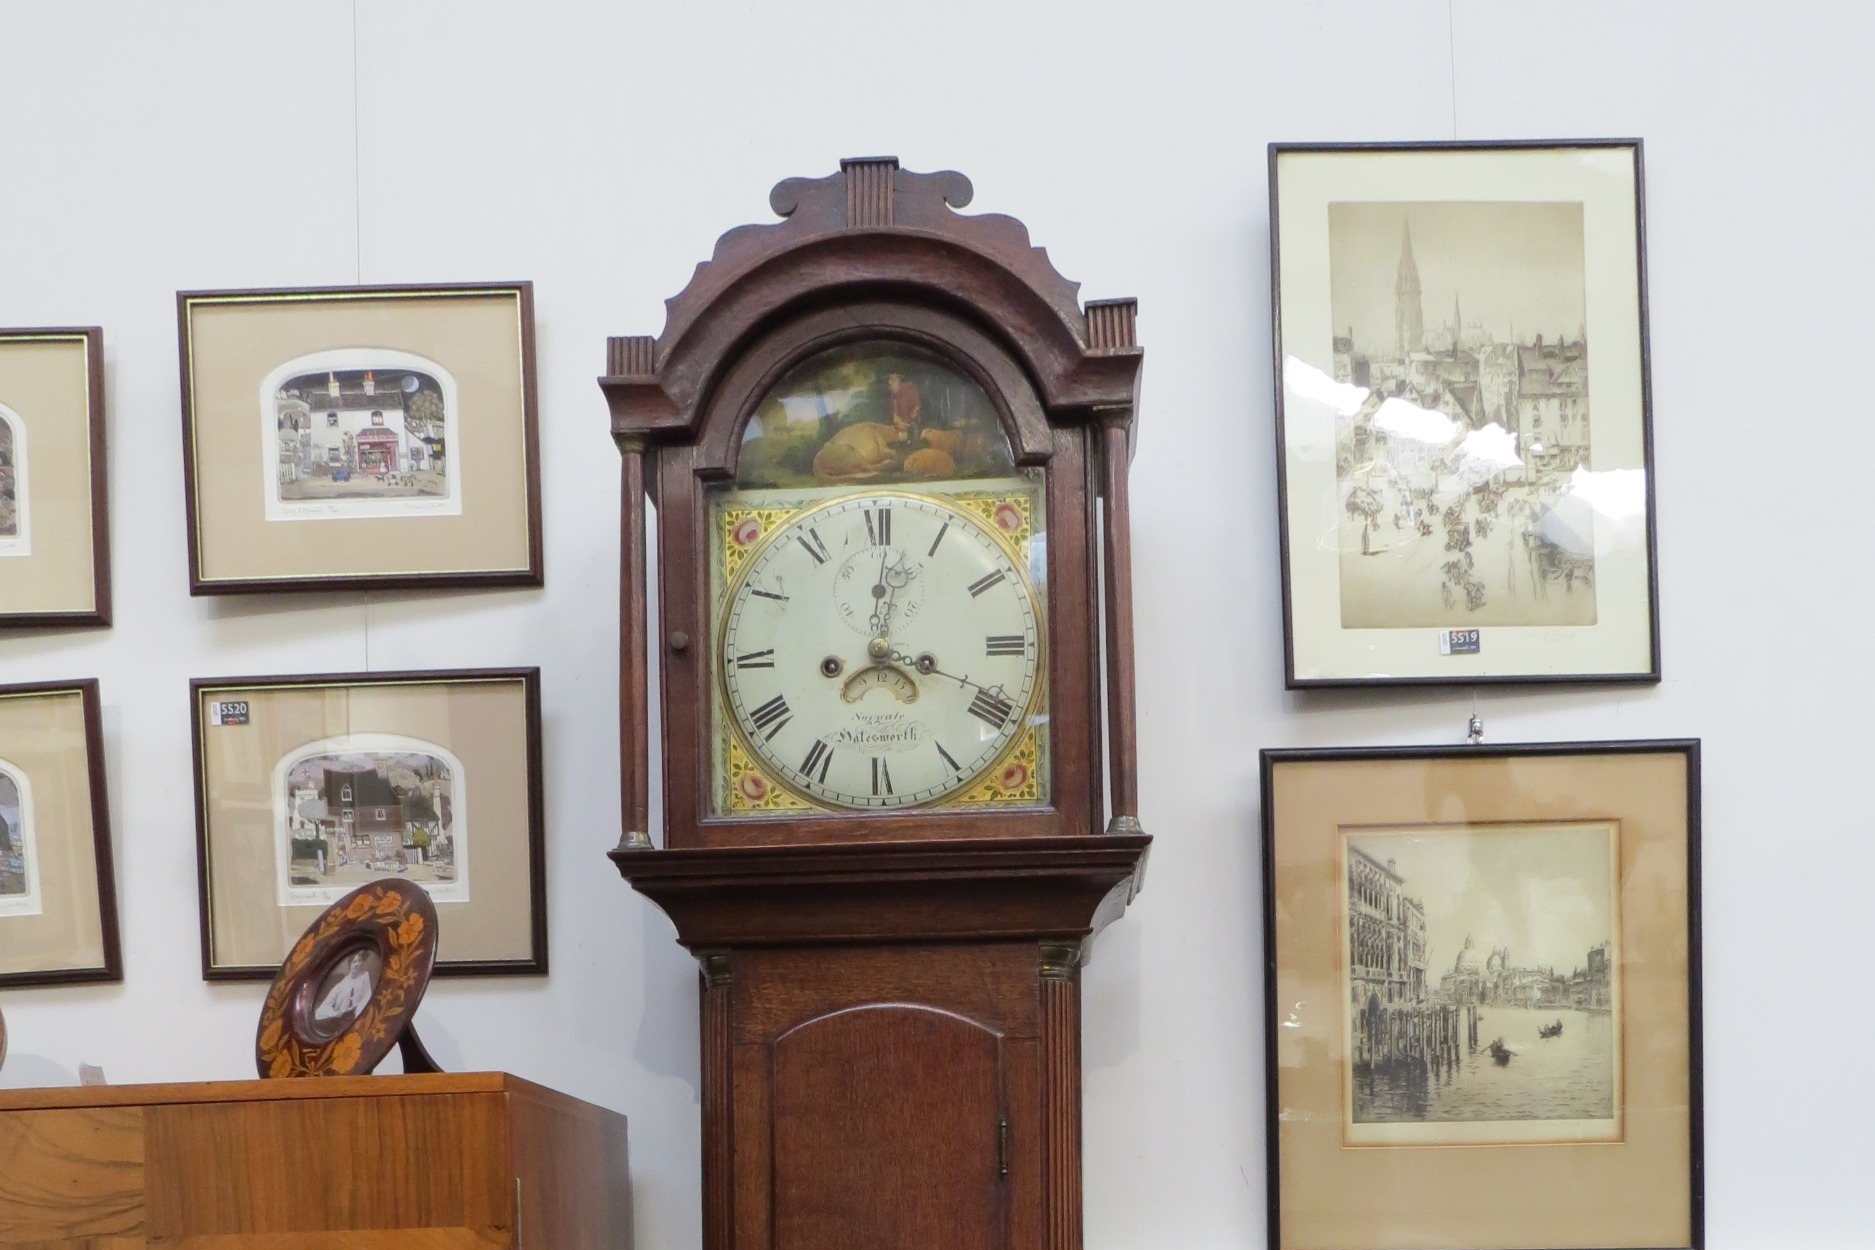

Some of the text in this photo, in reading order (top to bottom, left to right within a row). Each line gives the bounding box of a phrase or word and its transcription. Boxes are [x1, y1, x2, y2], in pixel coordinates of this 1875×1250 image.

[863, 508, 892, 547] XII
[967, 567, 1006, 599] II
[985, 634, 1026, 658] III
[1451, 631, 1478, 643] 5519
[737, 647, 776, 670] IX
[221, 703, 248, 715] 5520
[749, 692, 795, 744] VIII
[967, 687, 1014, 730] IIII
[799, 739, 835, 785] VII
[871, 756, 894, 796] VI
